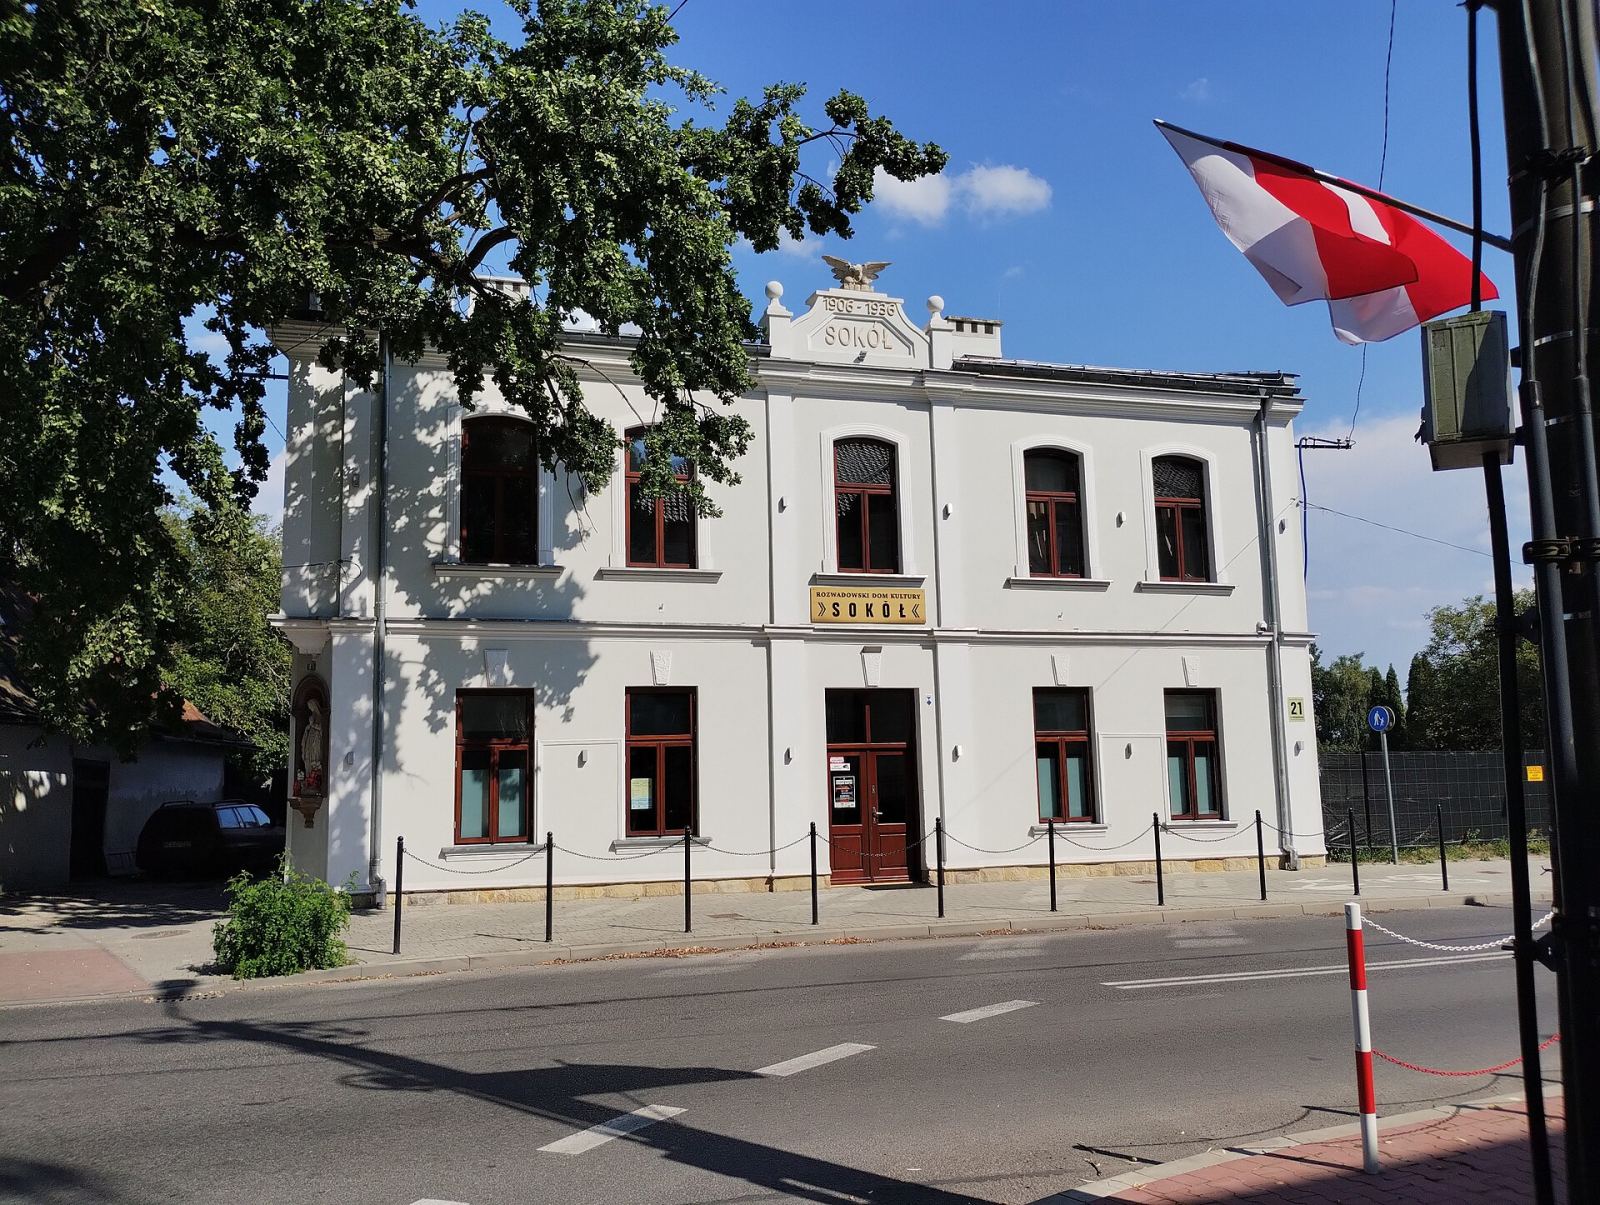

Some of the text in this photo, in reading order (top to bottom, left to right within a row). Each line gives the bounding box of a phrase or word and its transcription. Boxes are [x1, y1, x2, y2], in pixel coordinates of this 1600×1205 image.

[823, 299, 853, 313] 1906
[865, 303, 895, 316] 1936
[832, 601, 906, 618] SOKÓŁ
[1290, 701, 1303, 715] 21
